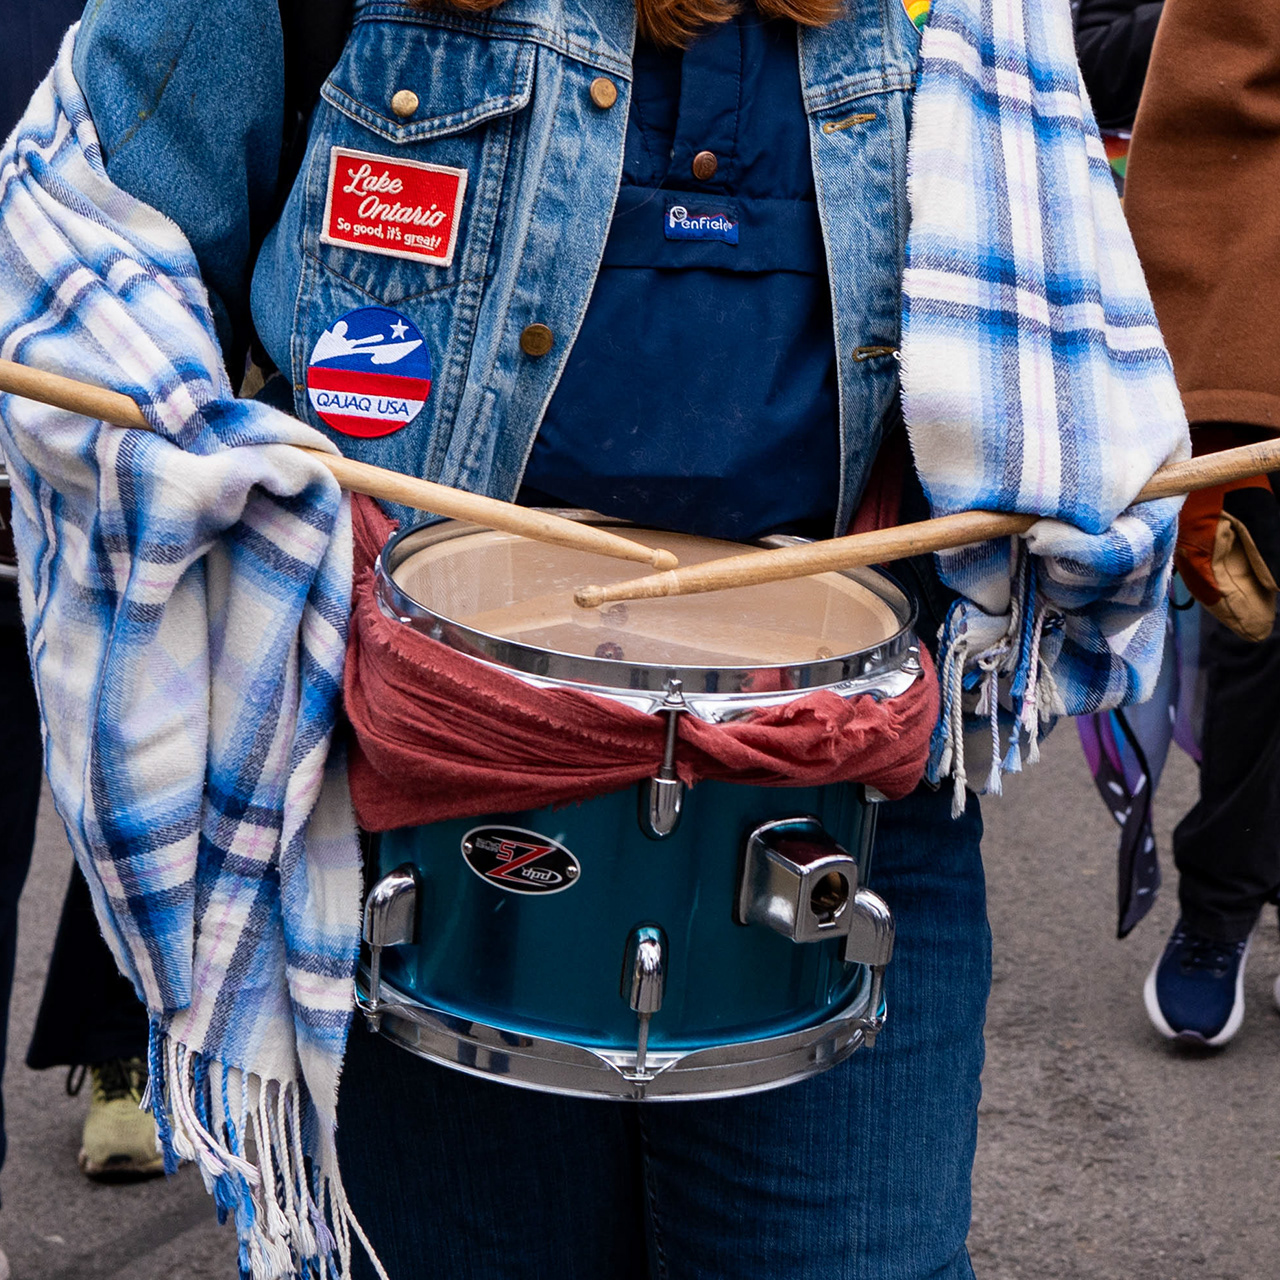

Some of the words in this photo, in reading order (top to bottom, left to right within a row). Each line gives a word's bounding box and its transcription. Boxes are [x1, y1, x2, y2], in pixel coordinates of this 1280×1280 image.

[343, 163, 403, 197] Lake
[358, 195, 448, 228] Ontario
[337, 217, 351, 232] So
[353, 223, 384, 239] good,
[386, 226, 402, 240] it's
[404, 233, 442, 250] great!
[316, 392, 372, 412] QAJAQ
[377, 399, 410, 417] USA
